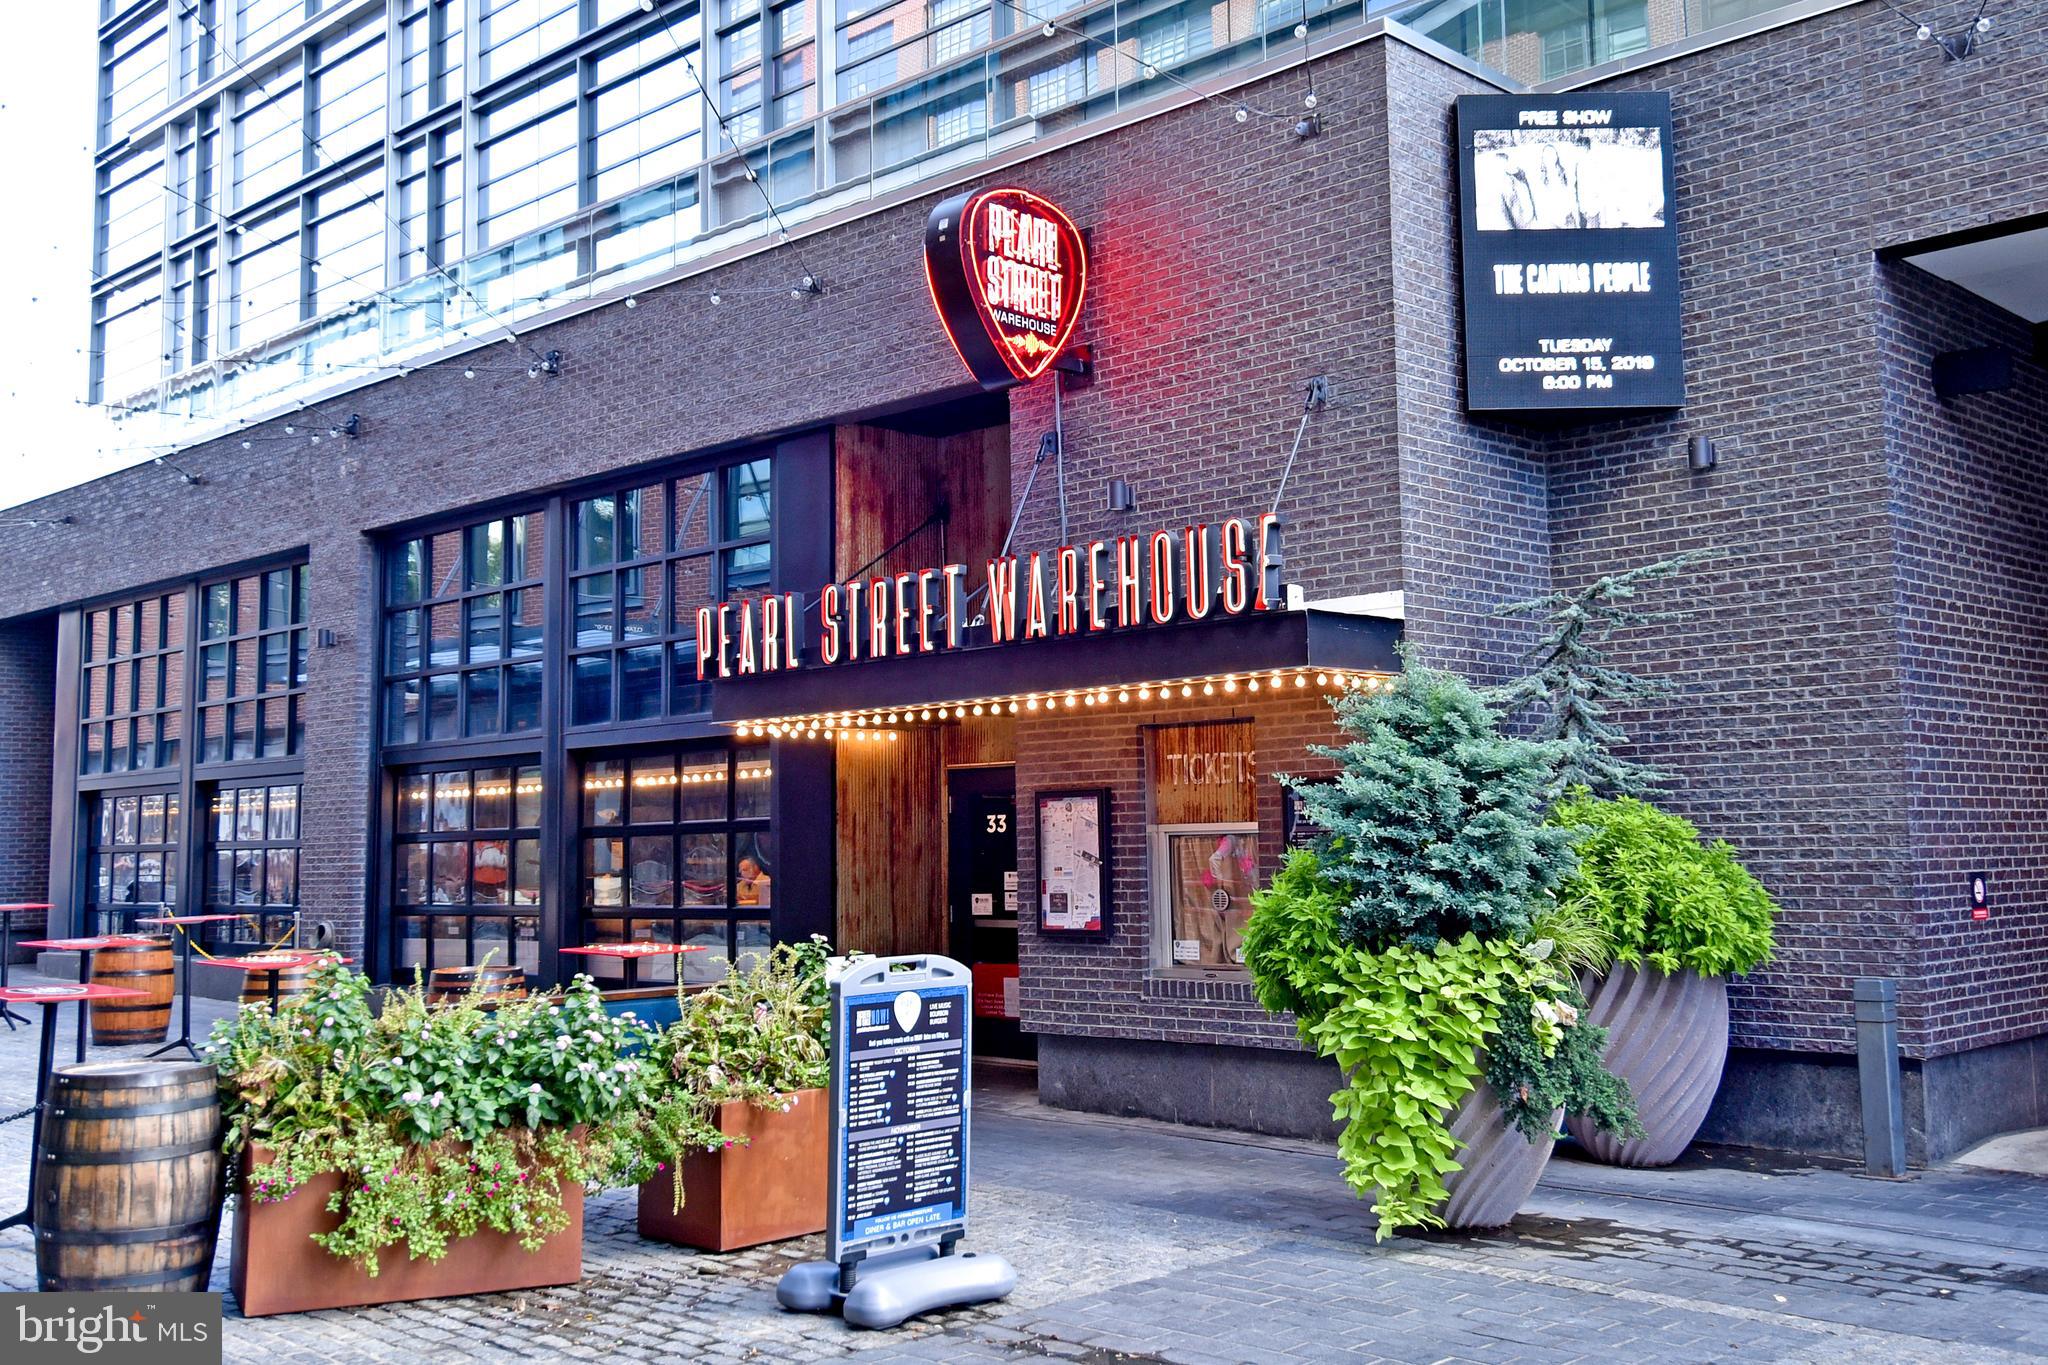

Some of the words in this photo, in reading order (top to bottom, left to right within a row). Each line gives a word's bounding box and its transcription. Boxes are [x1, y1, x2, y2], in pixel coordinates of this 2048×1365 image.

[1519, 110, 1558, 126] FREE
[1562, 109, 1612, 125] SHOW
[988, 203, 1061, 271] PEARL
[1493, 264, 1524, 295] THE
[1526, 263, 1591, 294] CANVAS
[1592, 261, 1651, 293] PEOPLE
[986, 255, 1063, 321] STREET
[993, 309, 1057, 337] WAREHOUSE
[1538, 338, 1613, 353] TUESDAY
[1499, 357, 1577, 372] OCTOBER
[1582, 356, 1607, 371] 15,
[1610, 355, 1655, 370] 2019
[1586, 374, 1613, 389] PM
[696, 591, 800, 681] PEARL
[821, 564, 963, 665] STREET
[986, 512, 1281, 643] WAREHOUSE
[1166, 751, 1257, 785] TICKETS
[986, 815, 1007, 833] 33
[890, 1123, 921, 1135] NOVEMBER
[893, 1220, 906, 1229] BAR
[907, 1216, 925, 1227] OPEN
[925, 1213, 942, 1223] LATE
